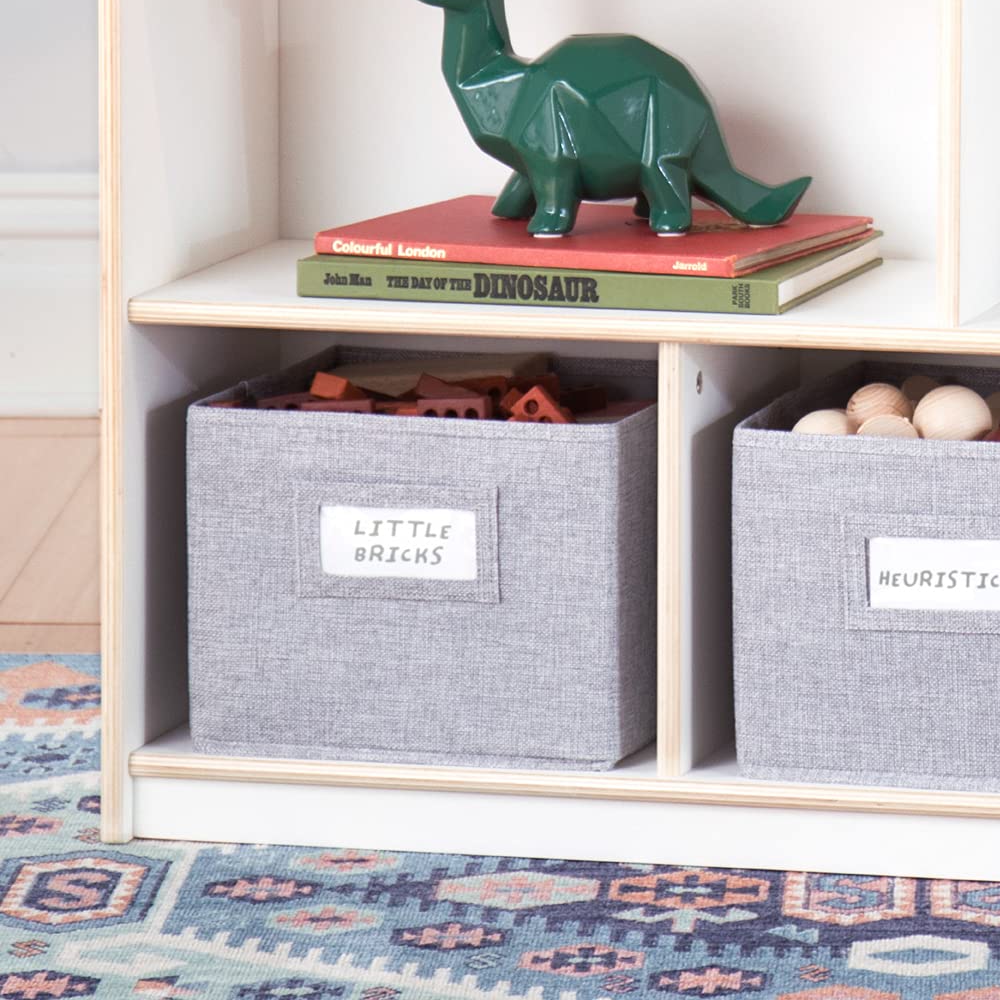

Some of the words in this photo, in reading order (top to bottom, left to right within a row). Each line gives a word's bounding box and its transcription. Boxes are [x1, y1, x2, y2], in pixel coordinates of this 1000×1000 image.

[332, 240, 393, 256] Colourful
[398, 244, 446, 259] London
[672, 261, 707, 271] Jarrold
[323, 273, 347, 286] John
[349, 273, 372, 286] Man
[386, 275, 409, 288] THE
[411, 276, 432, 290] DAY
[433, 277, 447, 290] OF
[449, 278, 472, 291] THE
[473, 273, 600, 303] DINOSAUR
[354, 519, 452, 539] LITTLE
[354, 544, 444, 565] BRICKS
